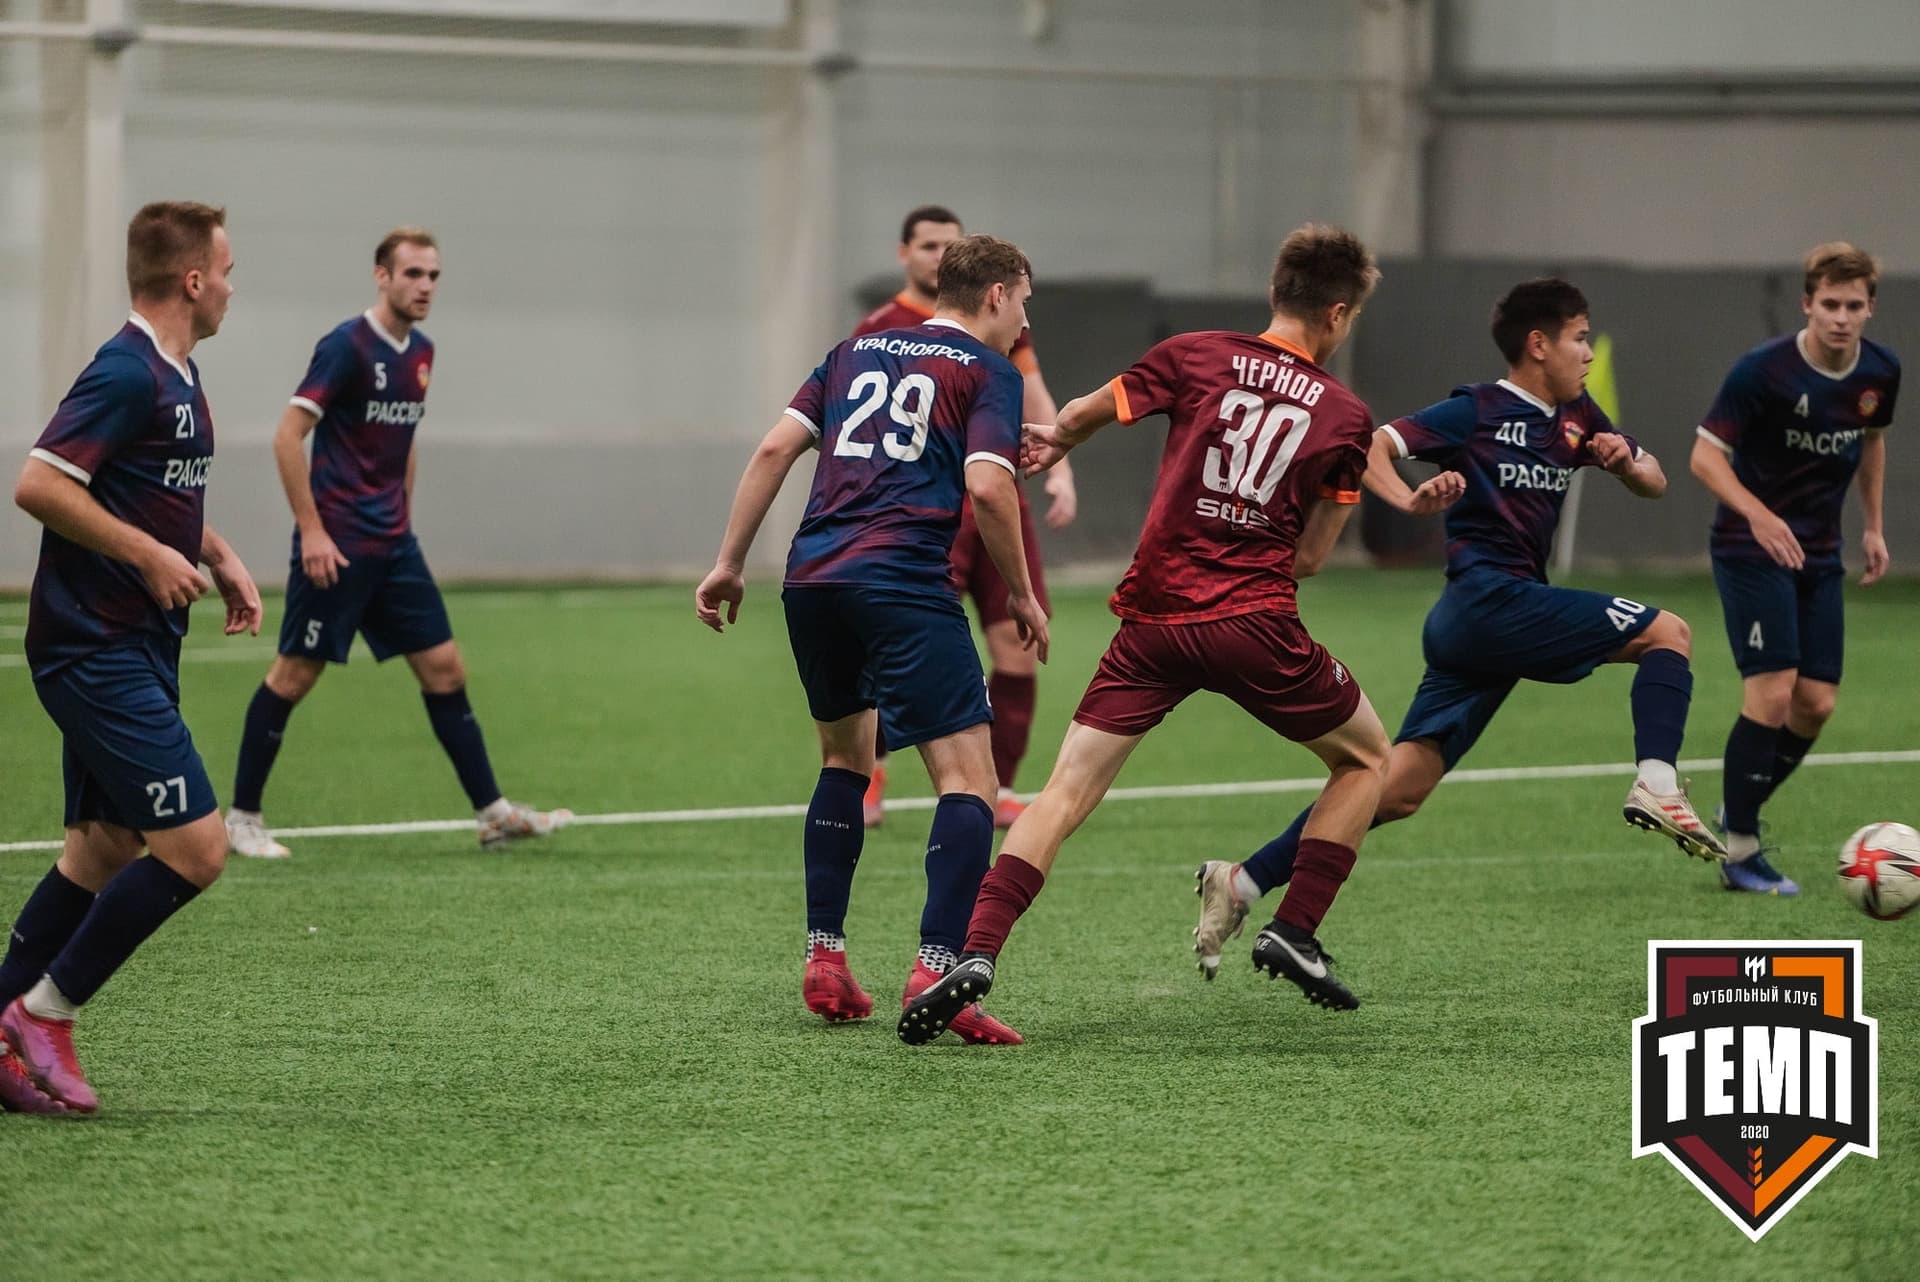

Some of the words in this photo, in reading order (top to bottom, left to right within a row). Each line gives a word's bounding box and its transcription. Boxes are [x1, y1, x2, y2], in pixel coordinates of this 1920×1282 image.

[853, 337, 978, 366] КРАСНОЯРСК
[374, 362, 387, 391] 5
[1232, 355, 1325, 407] ЧЕРНОВ
[833, 370, 936, 463] 29
[1793, 393, 1809, 418] 4
[1202, 389, 1312, 506] 30
[1495, 421, 1527, 447] 40
[1497, 463, 1574, 491] РАССВ
[1605, 597, 1647, 632] 40
[304, 618, 322, 649] 5
[1748, 620, 1763, 651] 4
[145, 775, 188, 818] 27
